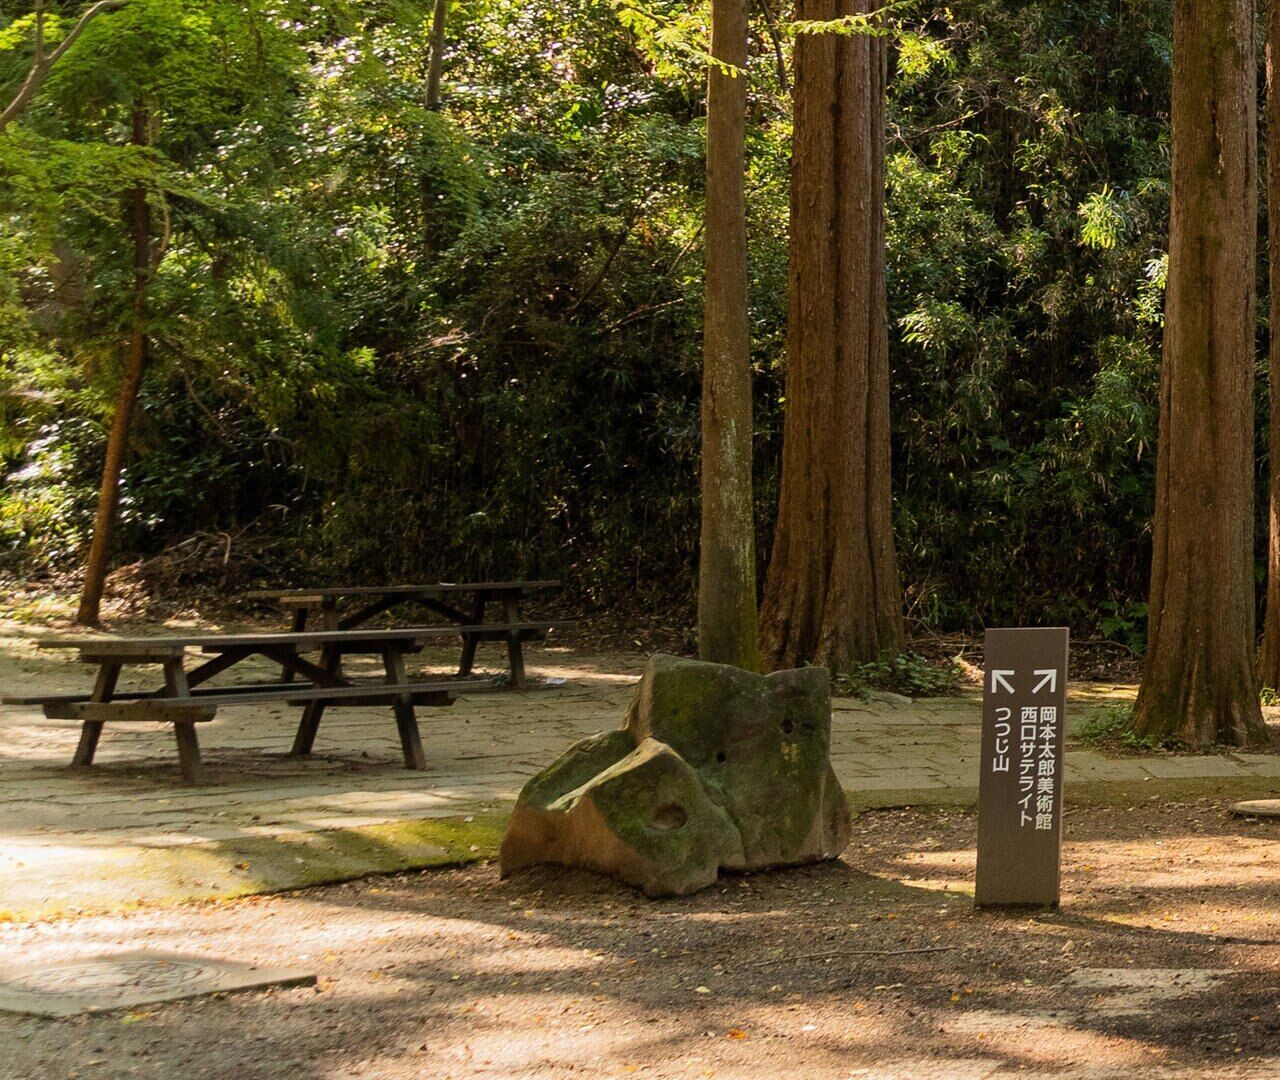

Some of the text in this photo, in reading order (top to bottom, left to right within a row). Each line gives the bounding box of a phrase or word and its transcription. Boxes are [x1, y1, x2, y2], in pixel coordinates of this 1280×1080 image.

[992, 707, 1012, 772] つつじ山
[1018, 706, 1038, 827] 西口サテライト
[1035, 706, 1057, 830] 岡本太郎美術館
